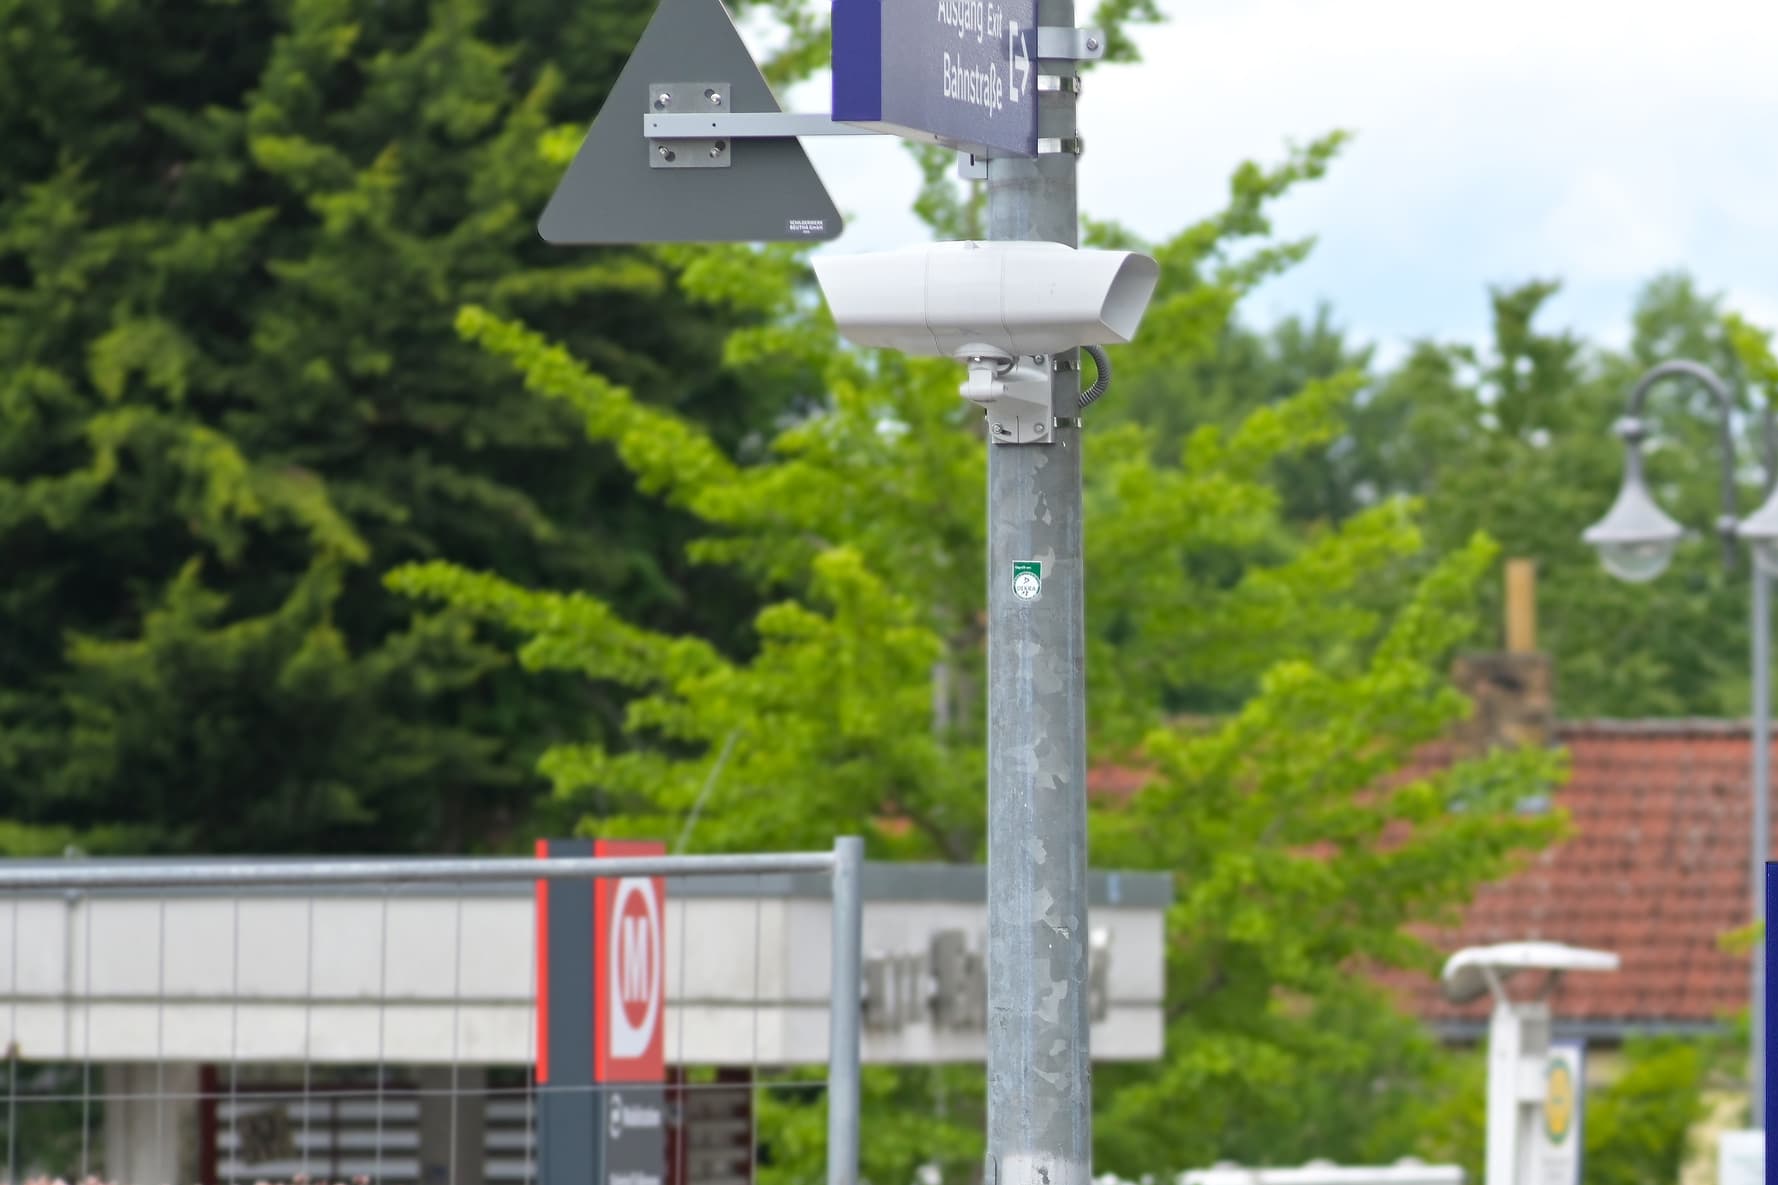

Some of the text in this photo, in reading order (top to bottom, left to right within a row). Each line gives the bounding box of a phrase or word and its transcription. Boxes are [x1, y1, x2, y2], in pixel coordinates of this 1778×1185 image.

[938, 0, 1003, 43] Ausgang Exit
[943, 51, 1003, 118] Bahnstraße
